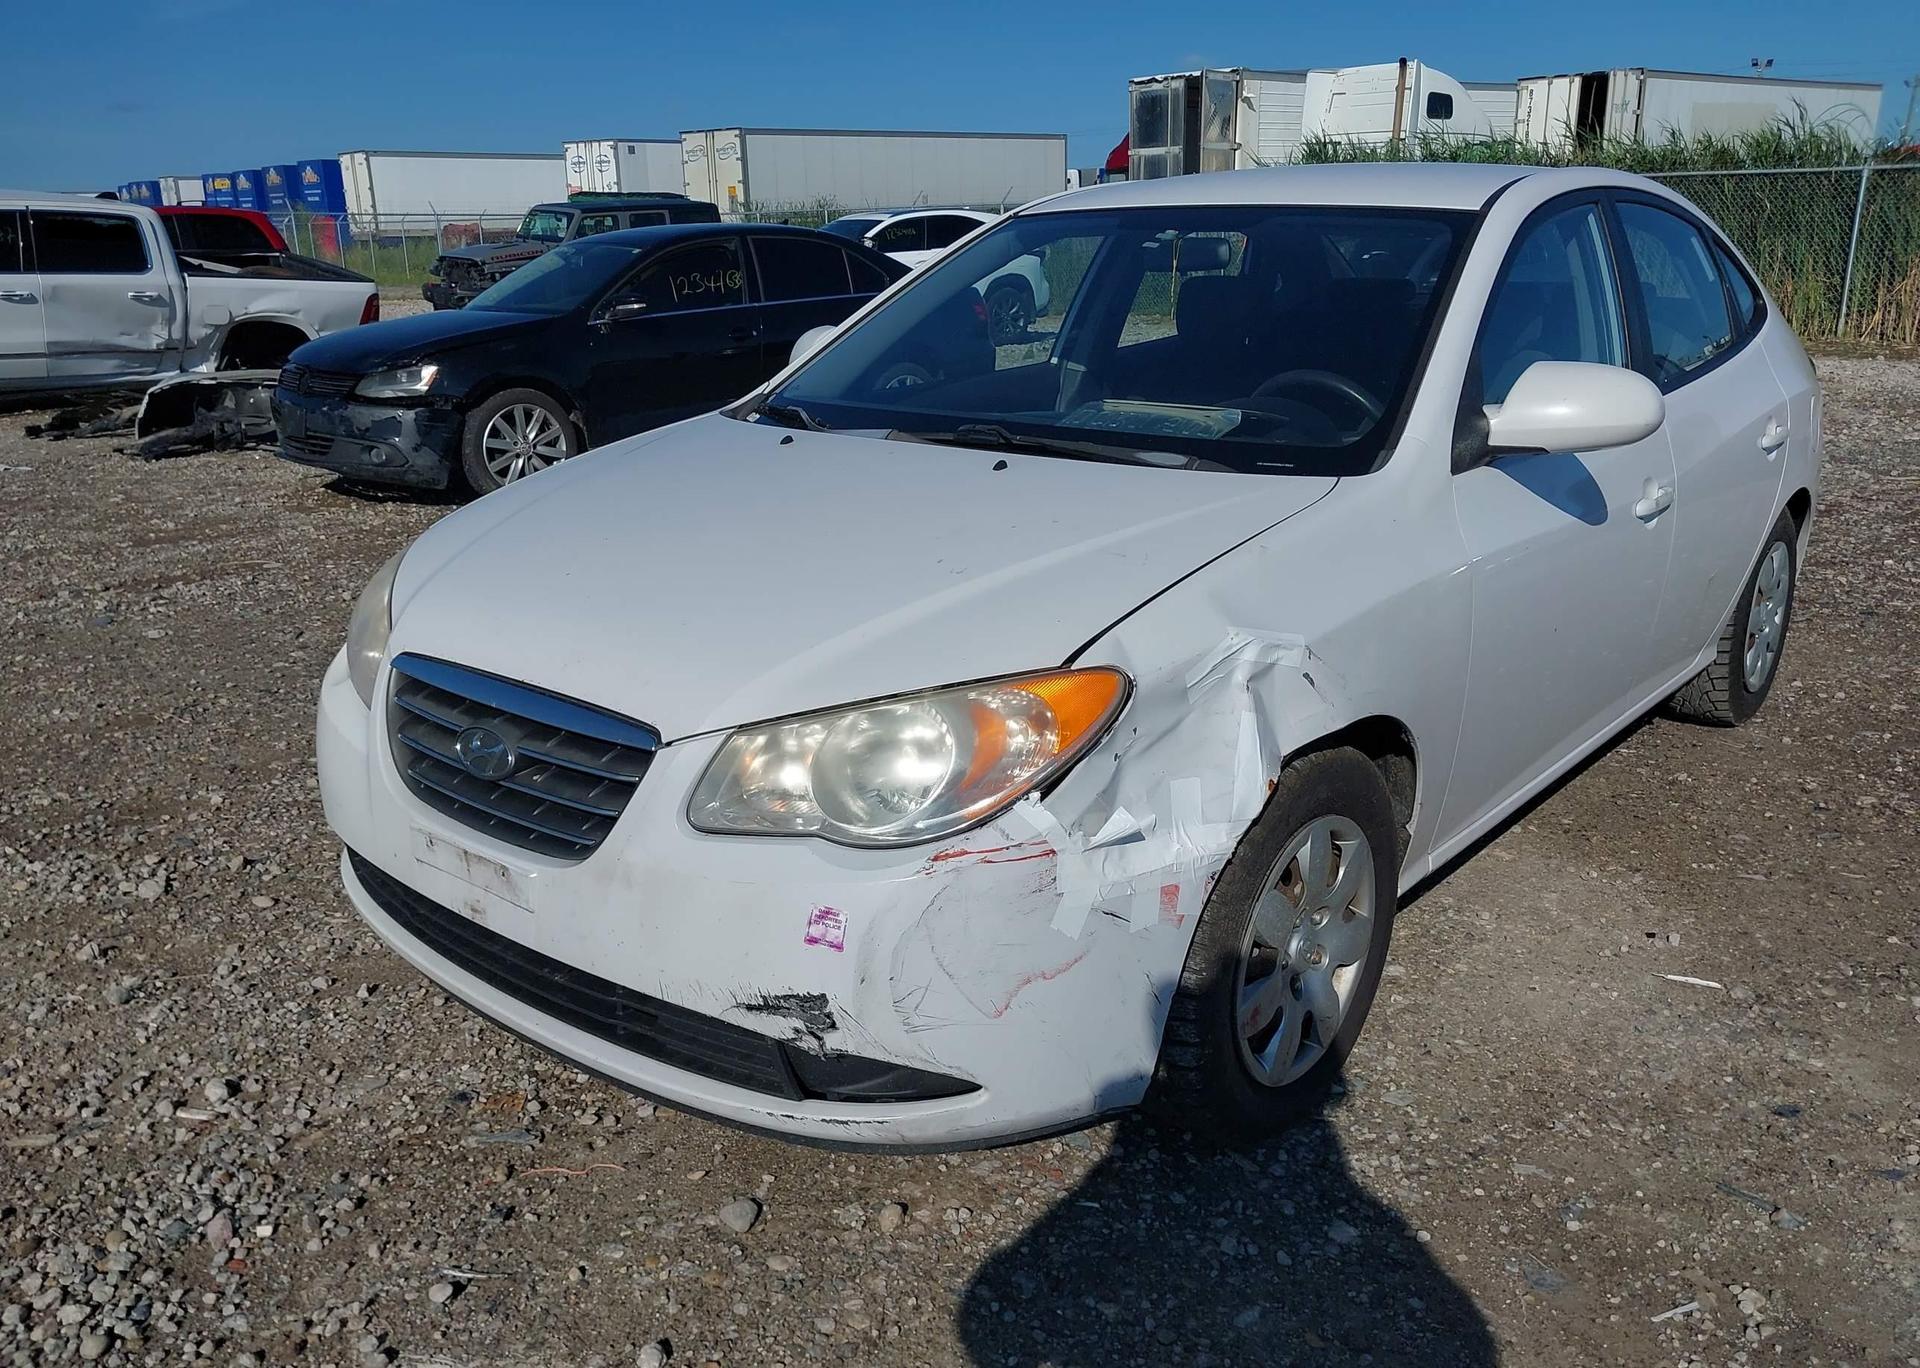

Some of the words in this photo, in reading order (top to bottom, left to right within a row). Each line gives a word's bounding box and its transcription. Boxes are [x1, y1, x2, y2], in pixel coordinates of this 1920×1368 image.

[490, 249, 544, 261] RUBICON
[818, 908, 841, 918] DAMAGE
[814, 913, 843, 925] REPORTED
[821, 921, 842, 931] POLICE
